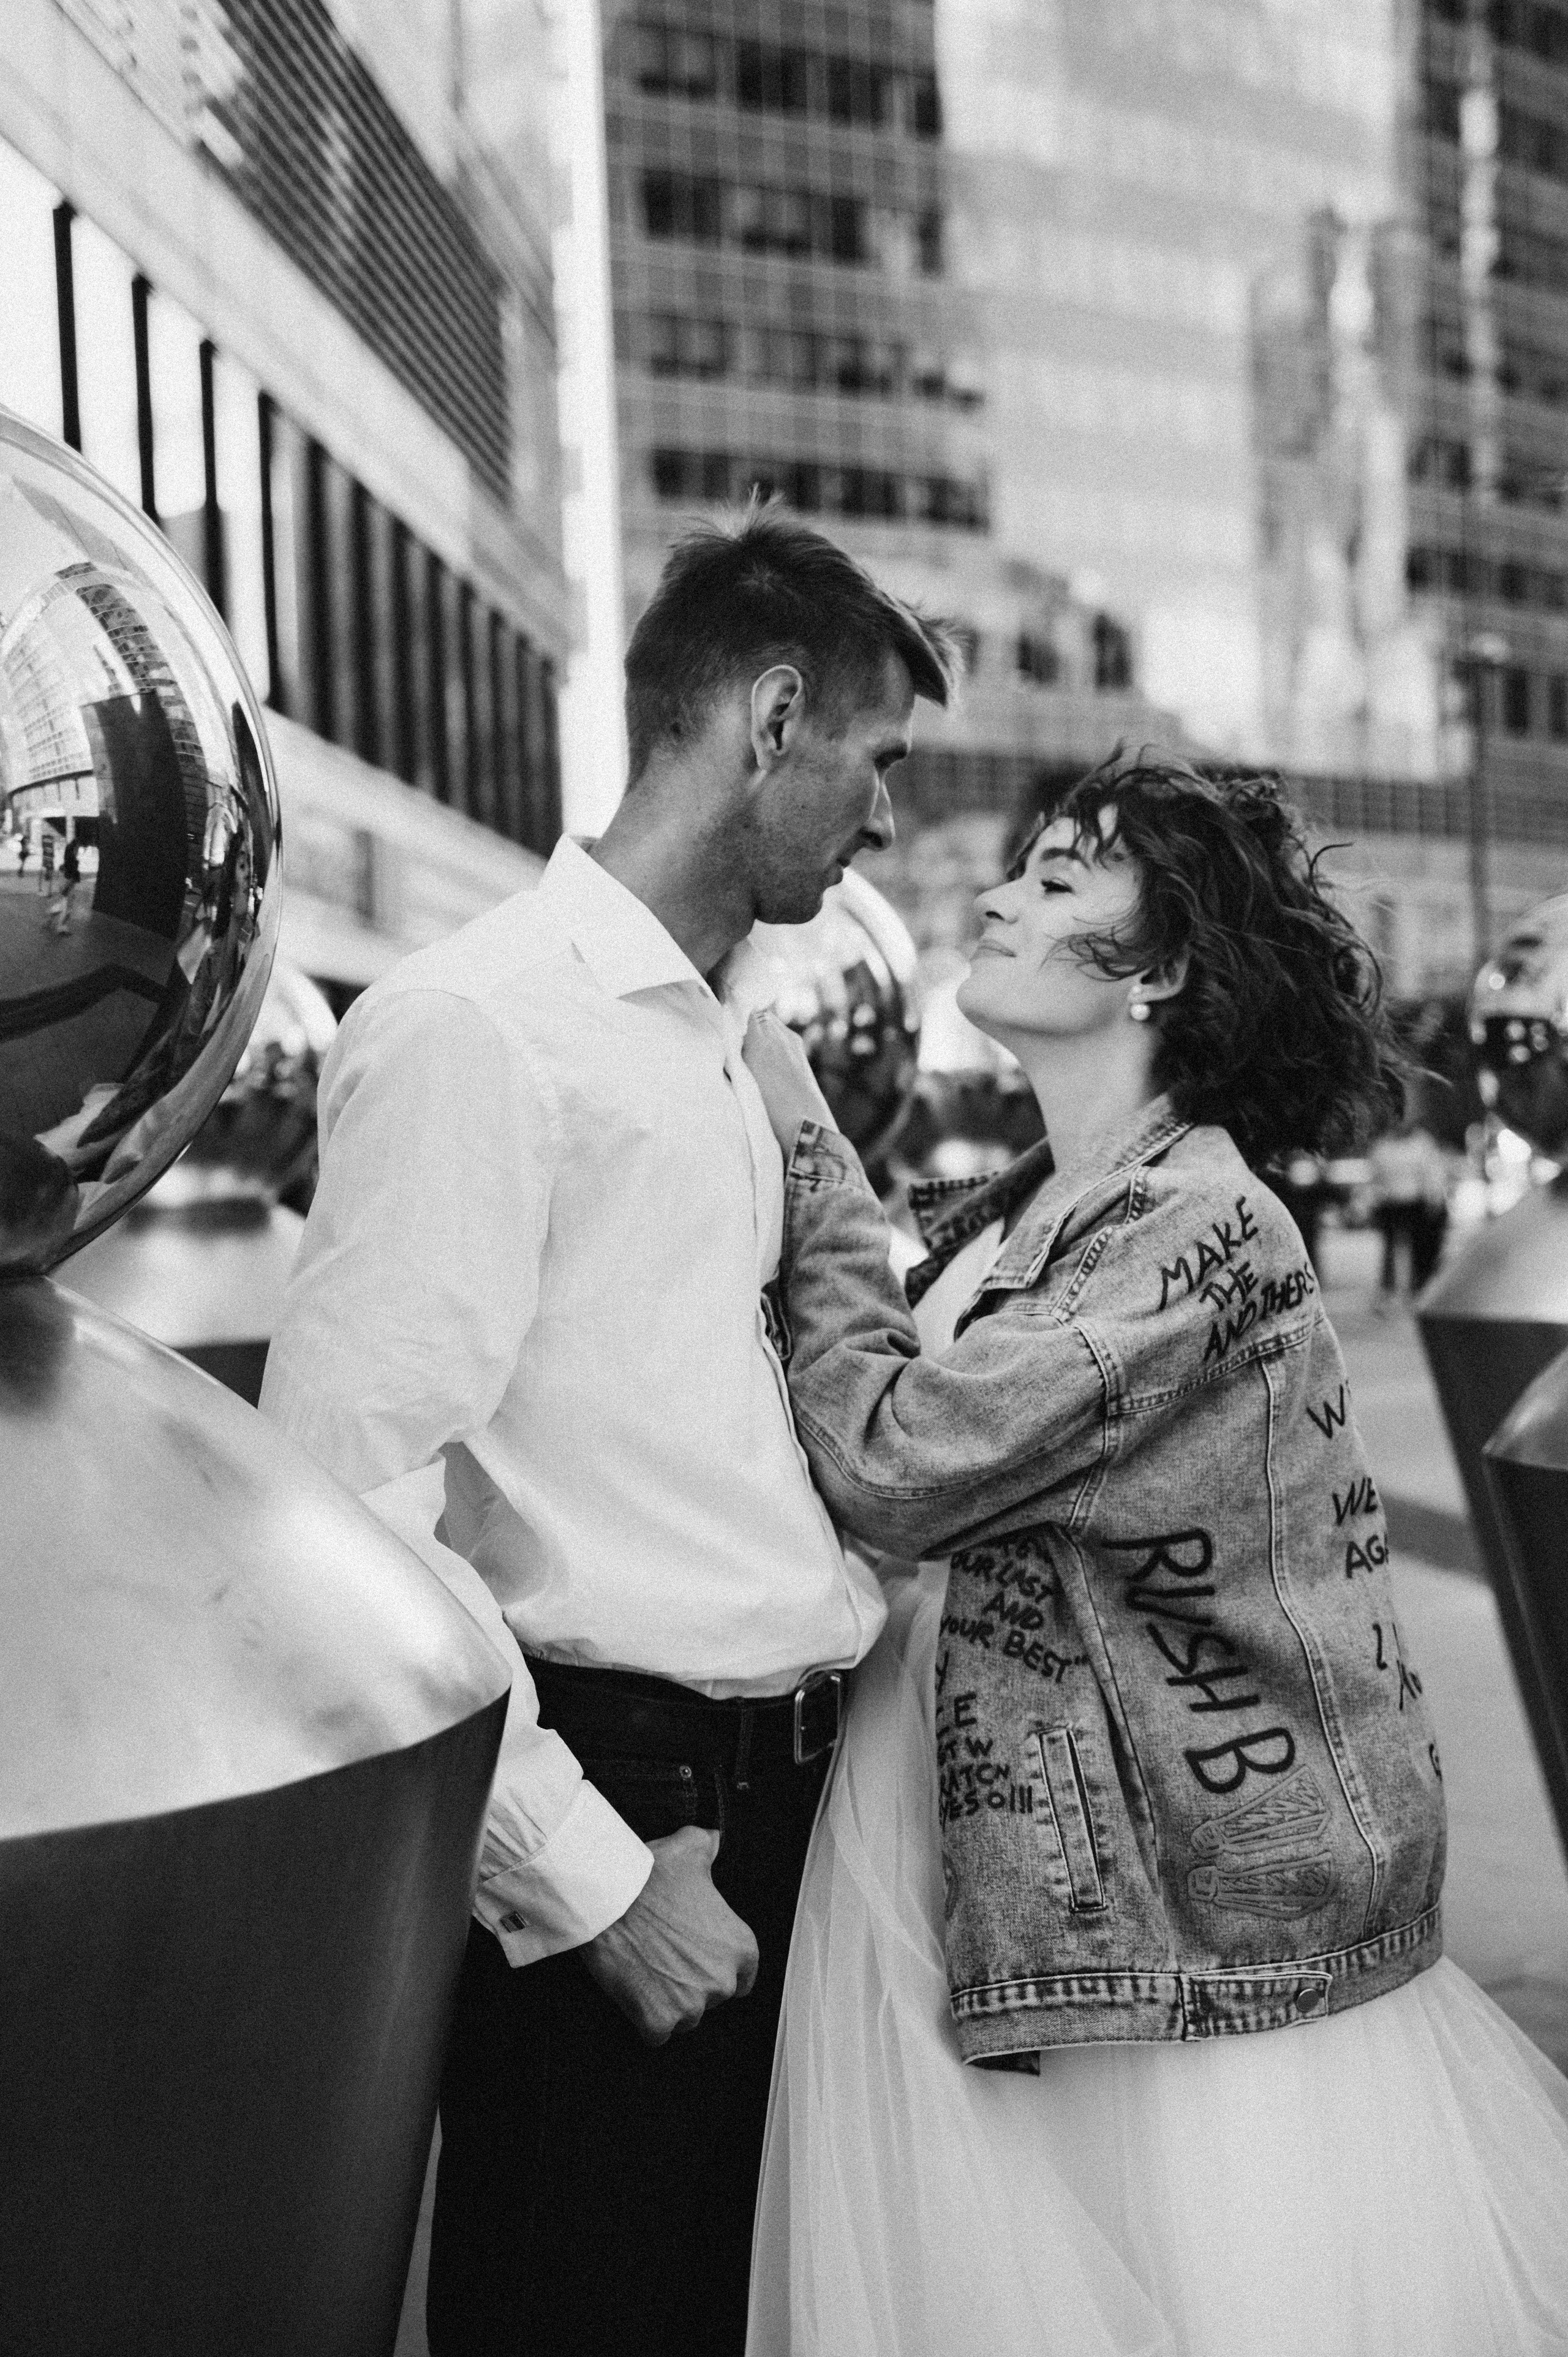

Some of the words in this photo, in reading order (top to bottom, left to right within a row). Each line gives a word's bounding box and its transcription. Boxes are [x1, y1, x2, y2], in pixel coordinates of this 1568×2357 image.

[1158, 1196, 1258, 1311] MAKE
[1199, 1261, 1259, 1312] THE
[981, 1590, 1043, 1631] AND
[1102, 1528, 1260, 1714] RUSH
[1183, 1727, 1296, 1794] B
